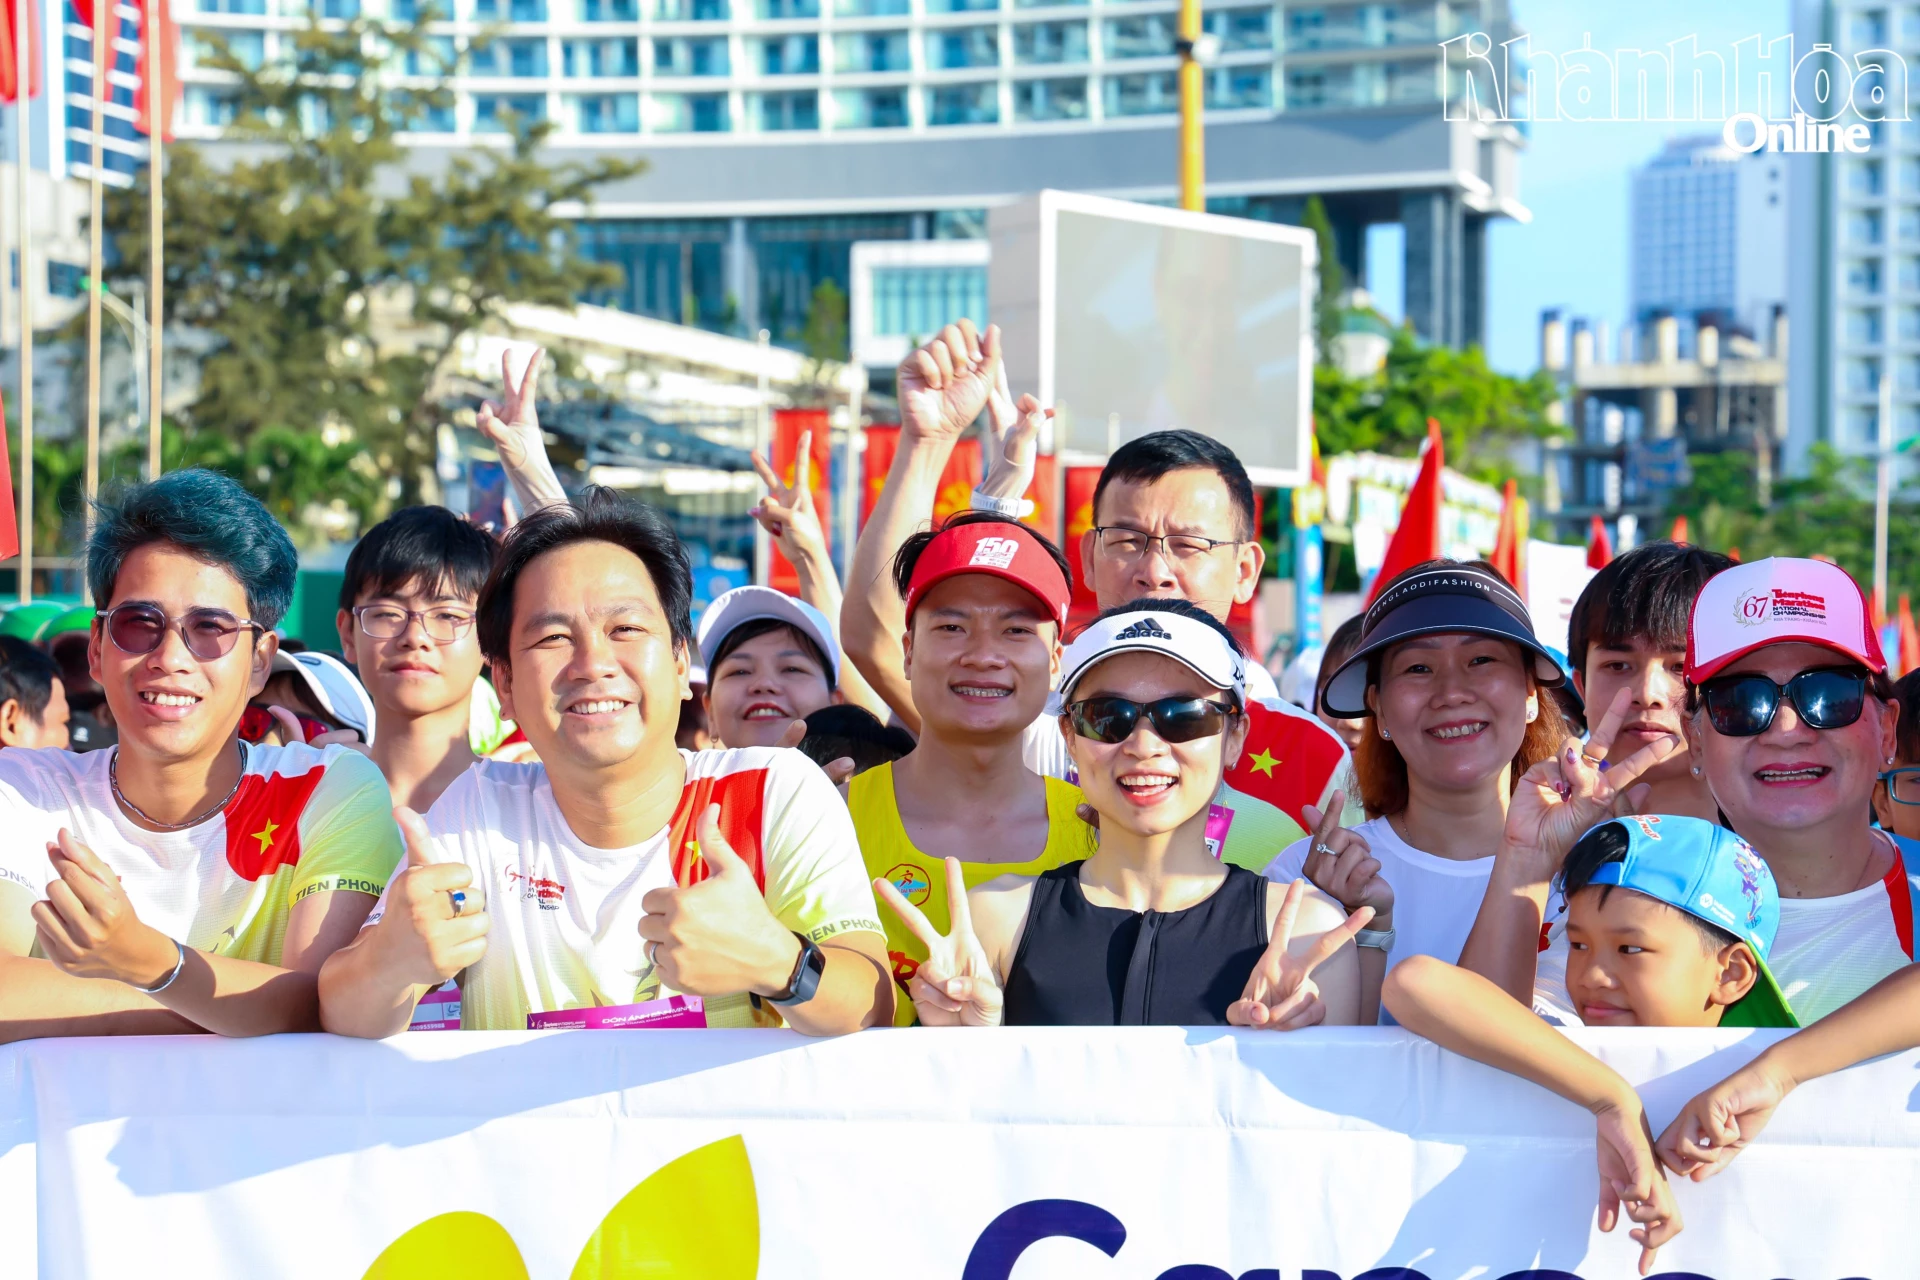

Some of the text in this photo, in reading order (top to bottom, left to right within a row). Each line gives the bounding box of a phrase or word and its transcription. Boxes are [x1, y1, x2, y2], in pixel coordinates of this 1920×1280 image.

[974, 536, 1020, 556] 150
[1743, 596, 1768, 618] 67
[1773, 599, 1825, 610] Marathon
[1115, 629, 1172, 641] adidas
[296, 880, 330, 901] TIEN
[806, 919, 881, 942] IEN PHON
[672, 1004, 693, 1014] MINH
